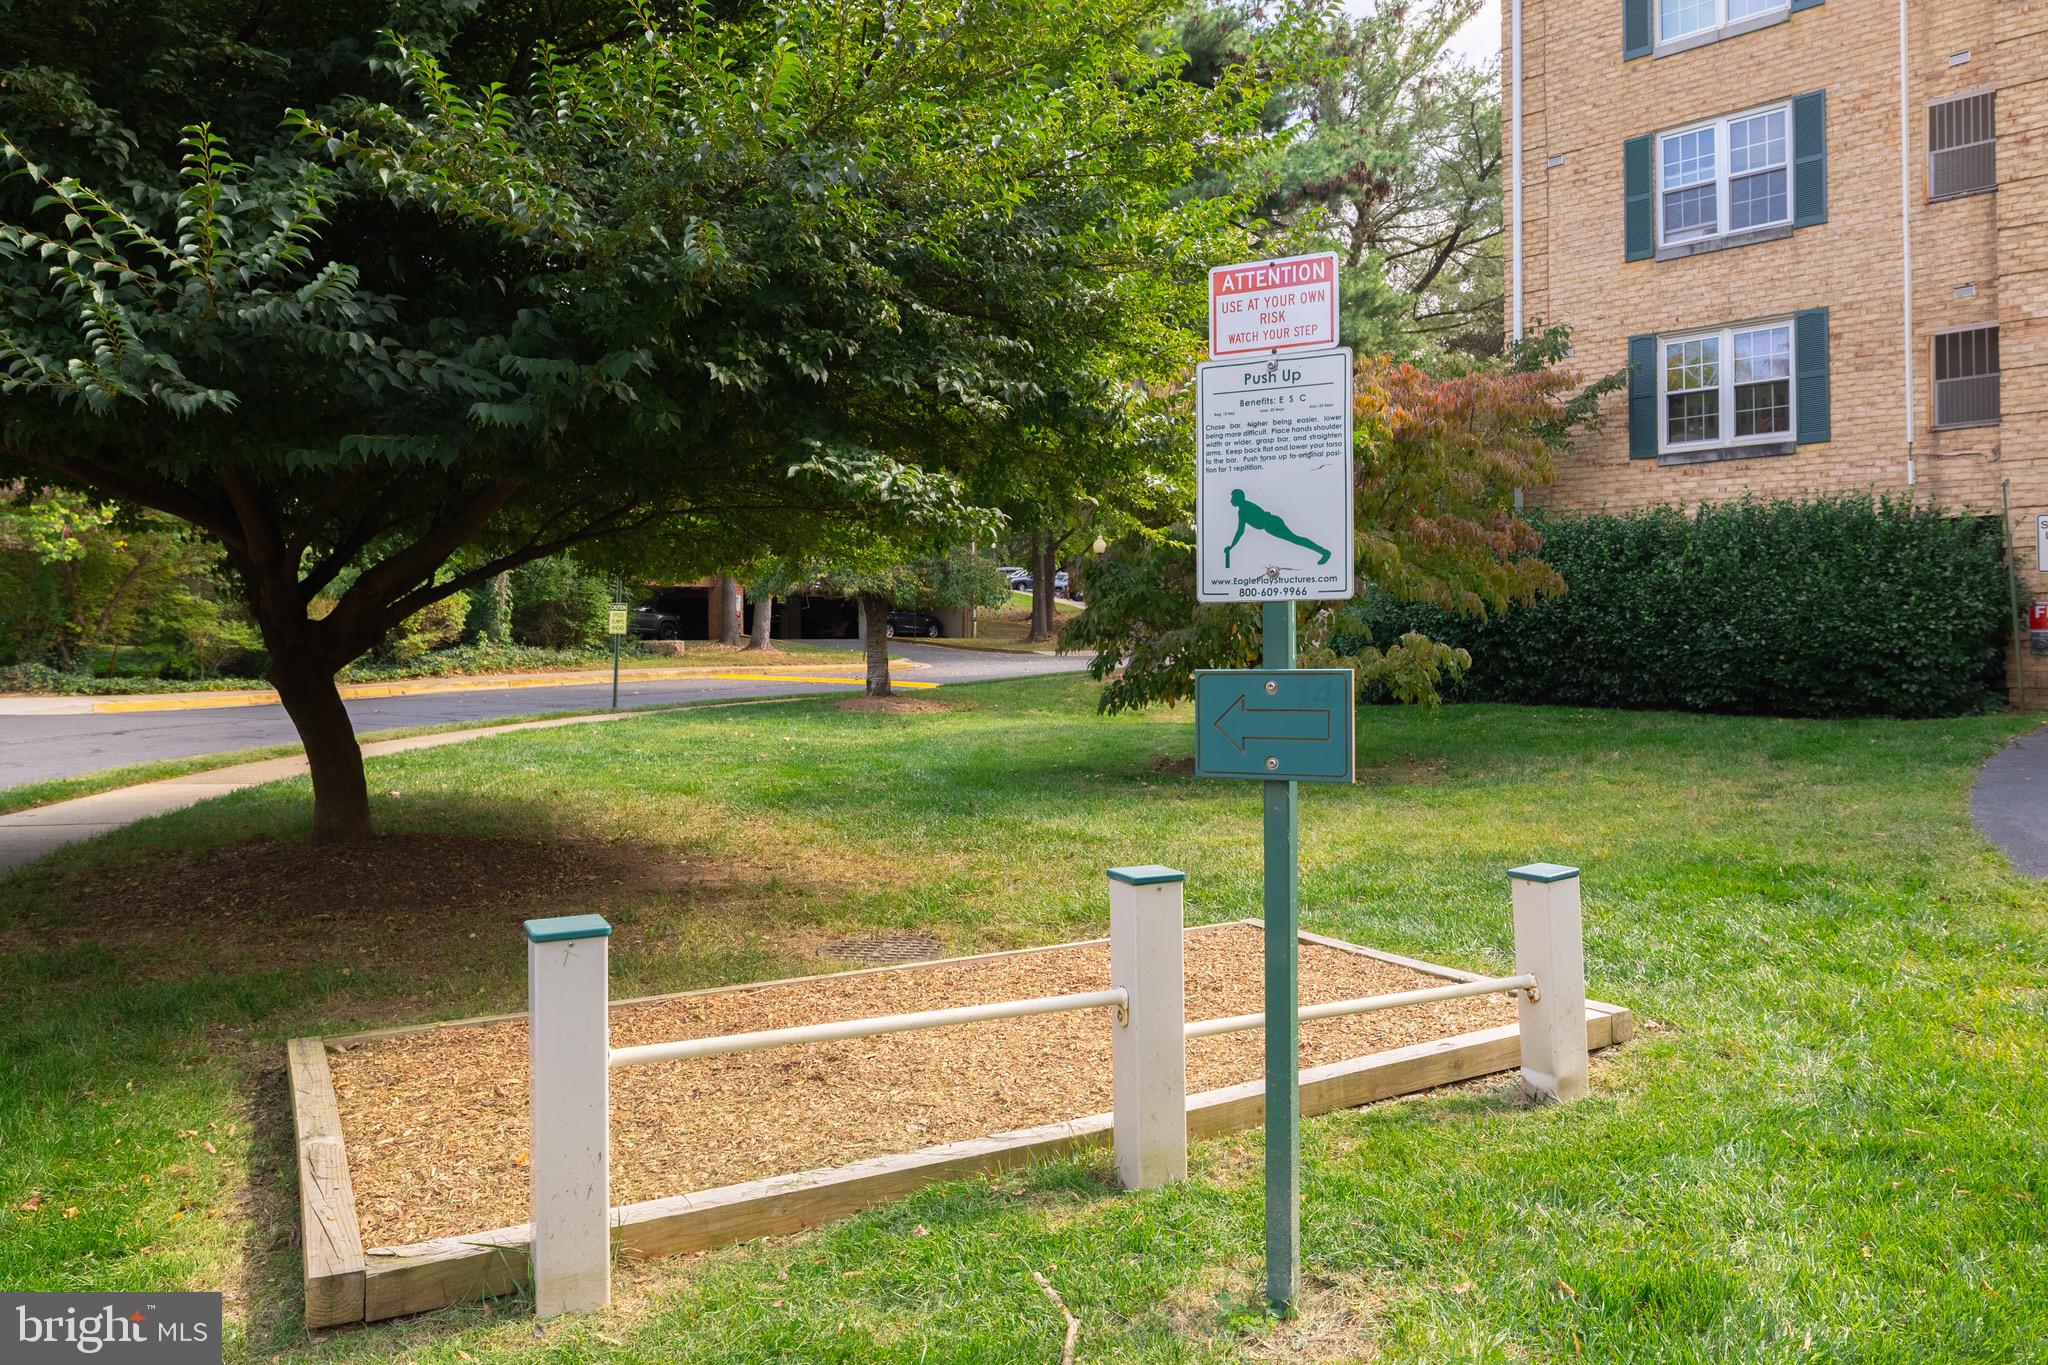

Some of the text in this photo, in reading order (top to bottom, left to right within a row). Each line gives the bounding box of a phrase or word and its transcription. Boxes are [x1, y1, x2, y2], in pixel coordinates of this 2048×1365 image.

[1222, 261, 1325, 292] ATTENTION
[1222, 289, 1325, 314] USE AT YOUR OWN
[1260, 310, 1286, 325] RISK
[1228, 324, 1318, 345] WATCH YOUR STEP
[1244, 369, 1302, 385] Push Up
[1240, 397, 1276, 407] Benefits:
[1299, 394, 1306, 402] C
[1310, 432, 1342, 440] straighten
[1298, 451, 1323, 459] original
[1211, 575, 1338, 586] www.EaglePlayStructures.com
